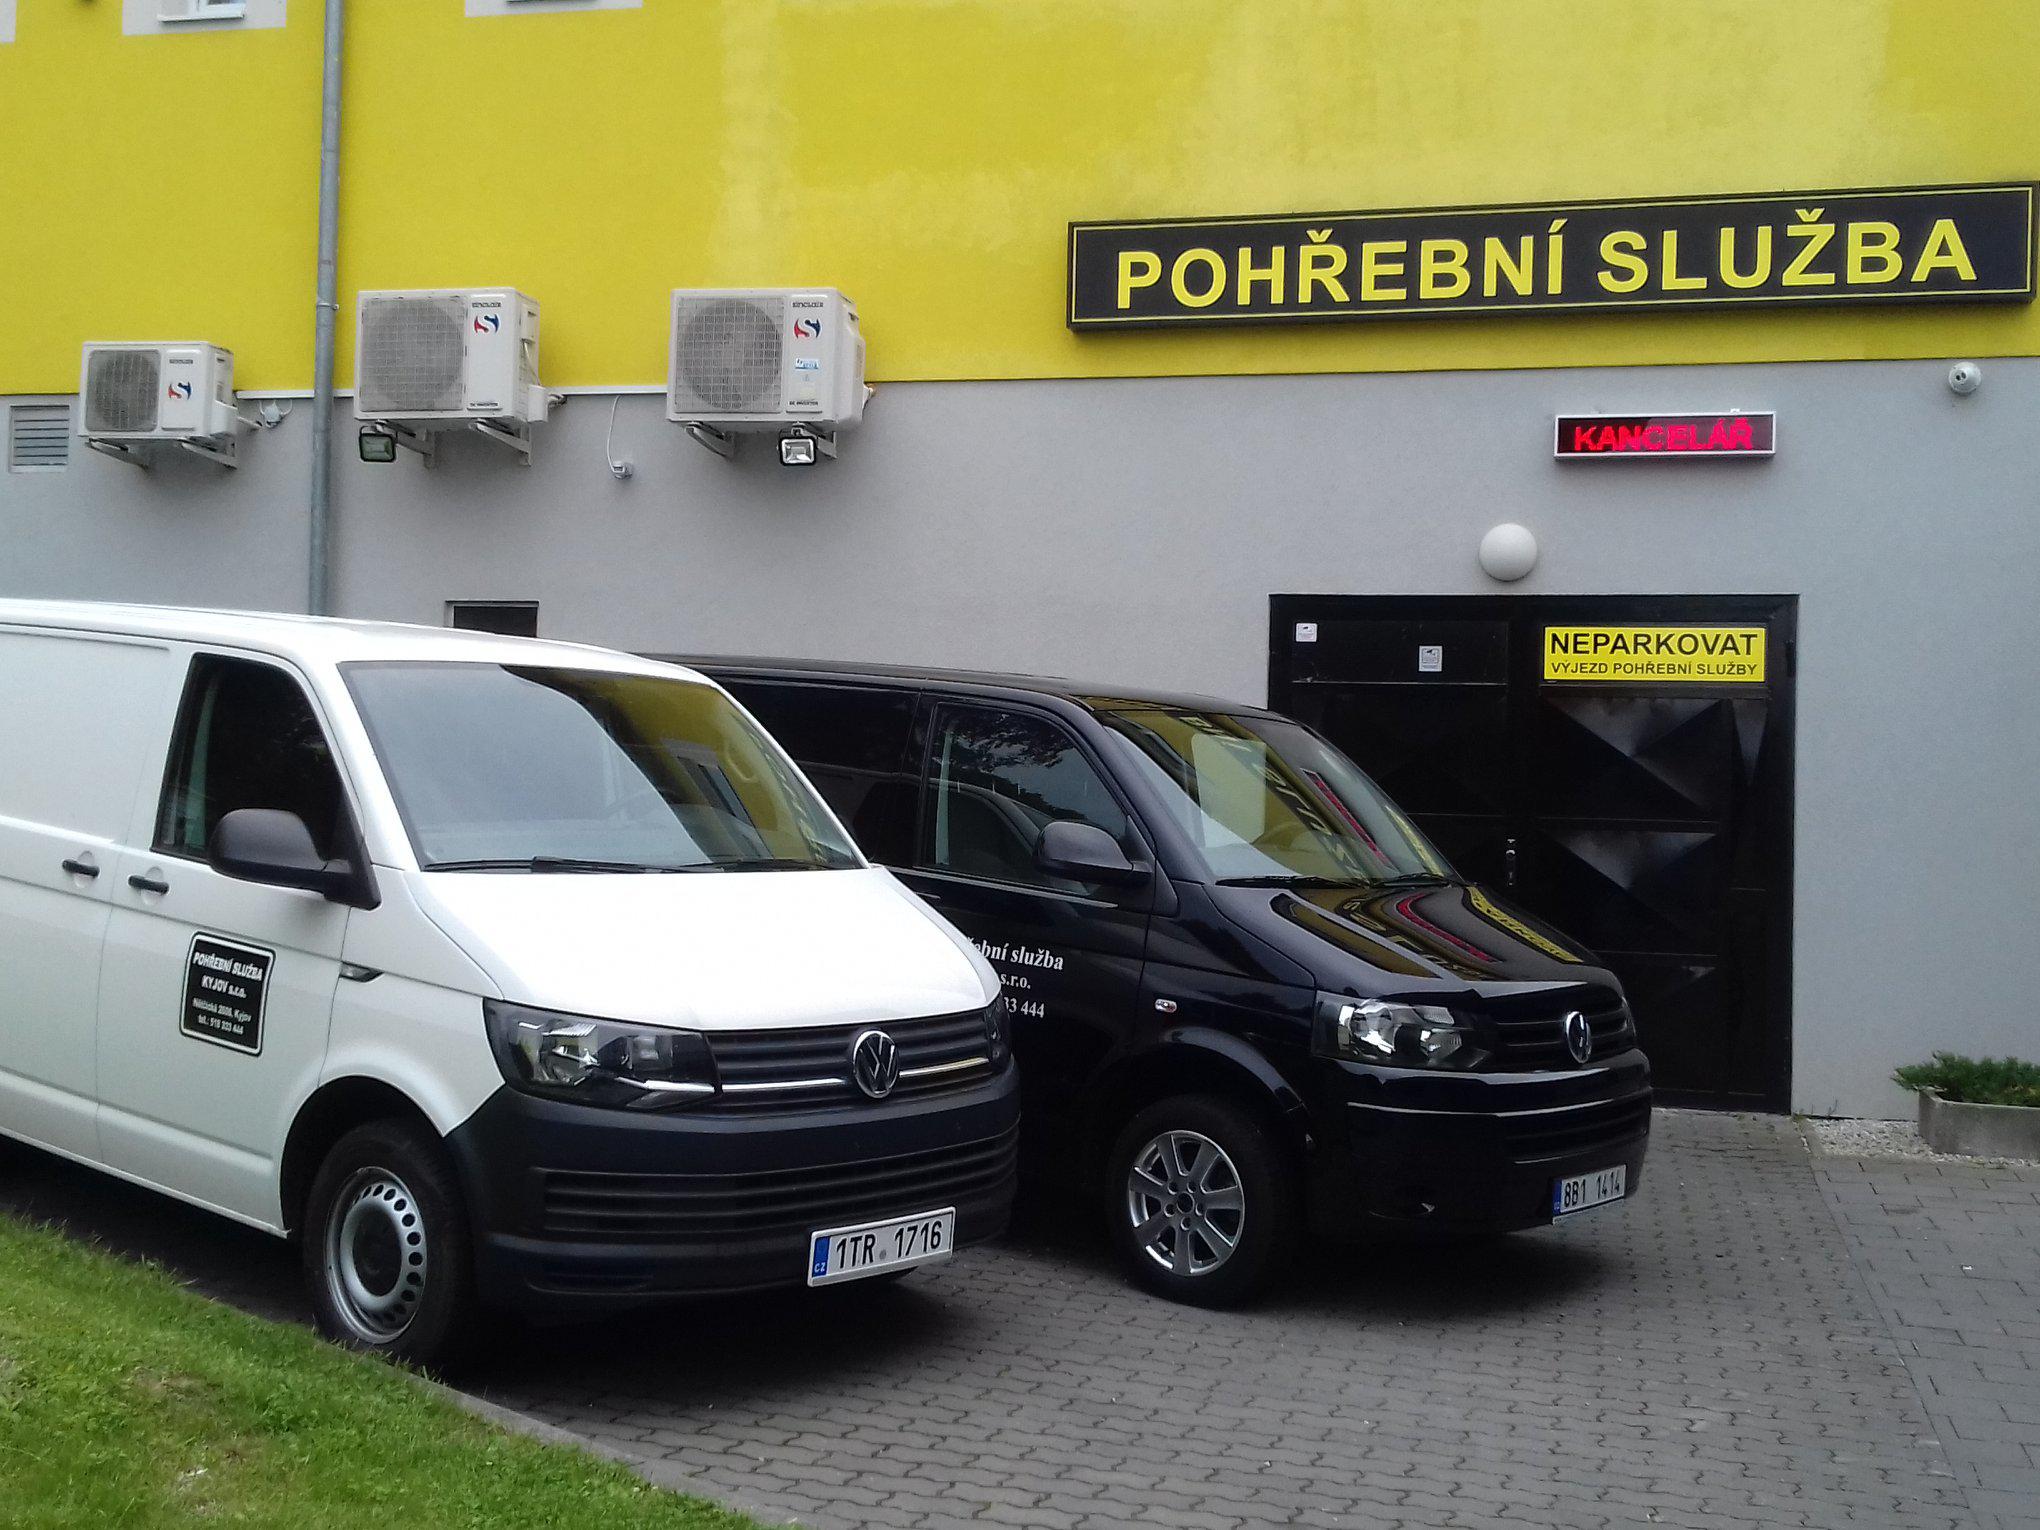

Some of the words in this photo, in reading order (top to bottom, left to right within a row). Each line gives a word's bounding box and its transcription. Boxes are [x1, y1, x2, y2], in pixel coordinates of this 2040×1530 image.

[1117, 218, 1568, 309] POHŘEBNÍ
[1597, 207, 1977, 293] SLUŽBA
[1574, 416, 1753, 451] KANCELÁŘ
[1550, 632, 1758, 656] NEPARKOVAT
[1551, 660, 1608, 674] VÝJEZD
[1612, 660, 1692, 675] POHŘEBNÍ
[1696, 661, 1757, 676] SLUŽBY
[1010, 945, 1064, 971] služba
[201, 974, 230, 993] KYJOV
[1000, 973, 1031, 990] s.r.o.
[1020, 1000, 1045, 1018] 444
[836, 1233, 876, 1269] 1TR
[894, 1220, 943, 1259] 1716
[814, 1262, 826, 1273] CZ
